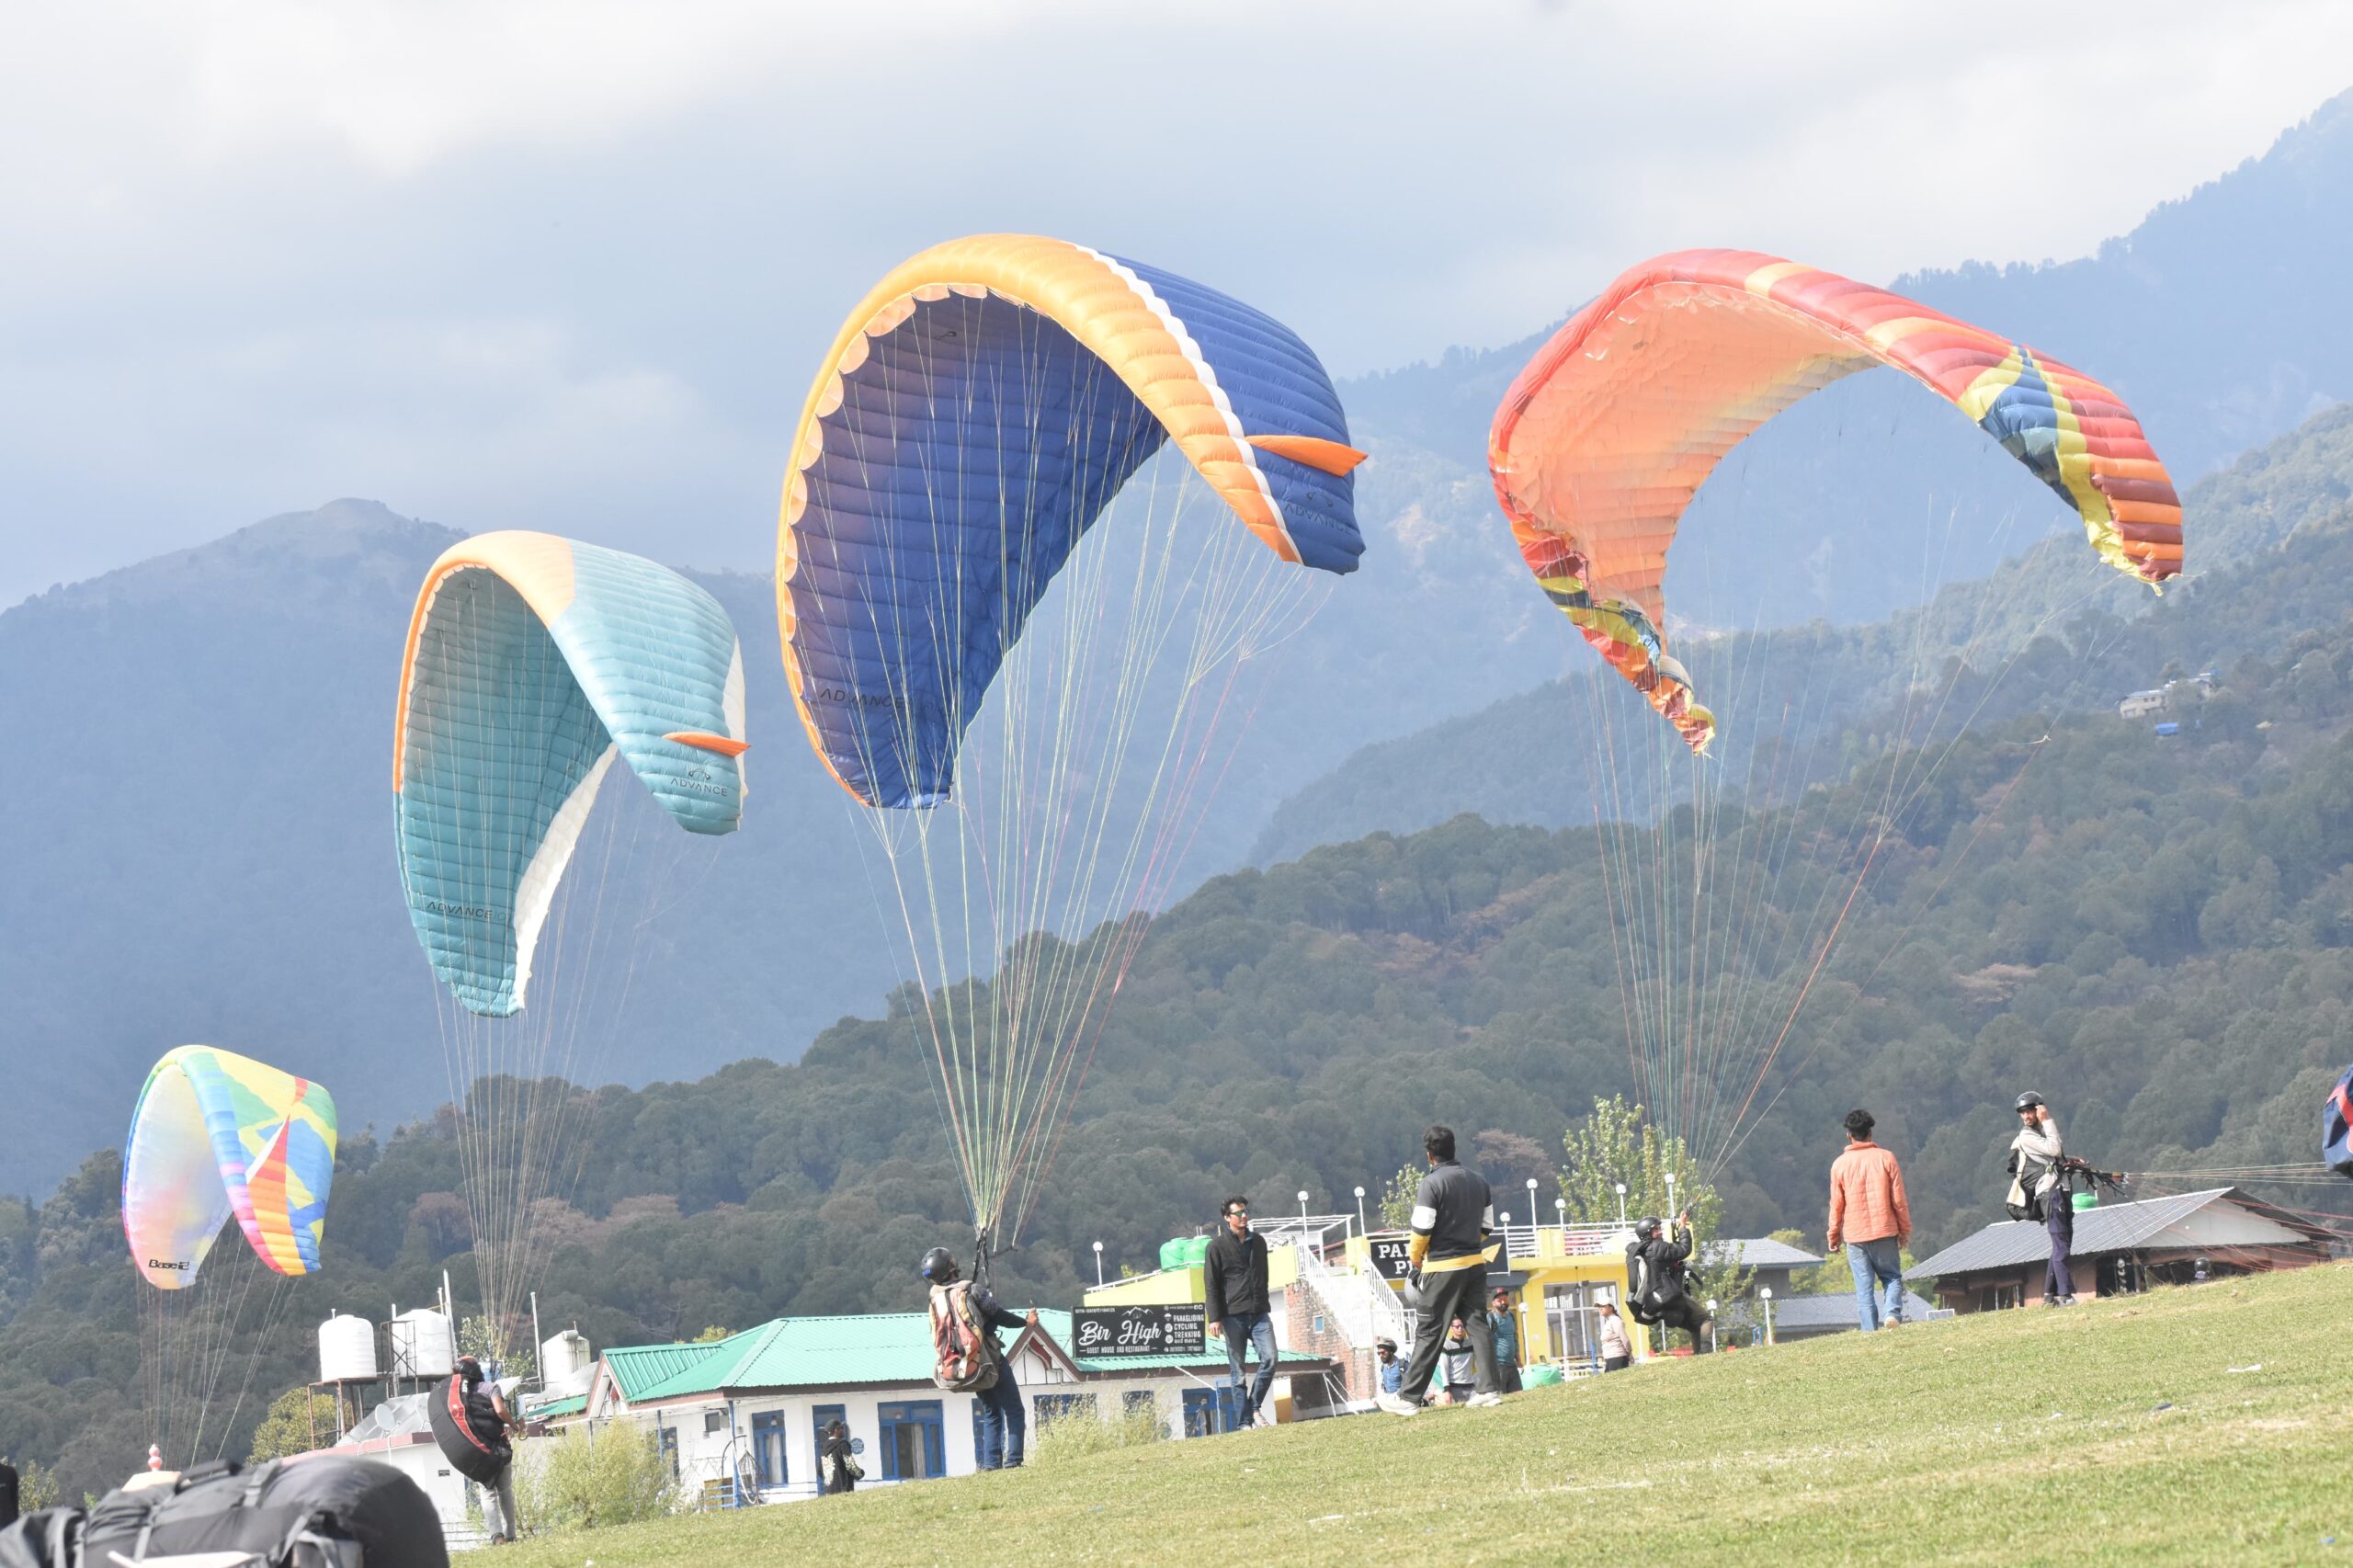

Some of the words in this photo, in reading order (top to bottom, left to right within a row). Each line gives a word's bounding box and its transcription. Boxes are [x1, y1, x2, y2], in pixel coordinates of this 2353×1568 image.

[1285, 504, 1353, 535] ADVANCE
[820, 688, 905, 708] ADVANCE
[671, 778, 728, 797] ADVANCE
[427, 902, 493, 919] ADVANCE
[149, 1258, 177, 1269] Base
[1078, 1321, 1111, 1346] Bir
[1118, 1320, 1163, 1346] High
[1125, 1345, 1150, 1353] RESTAURANT
